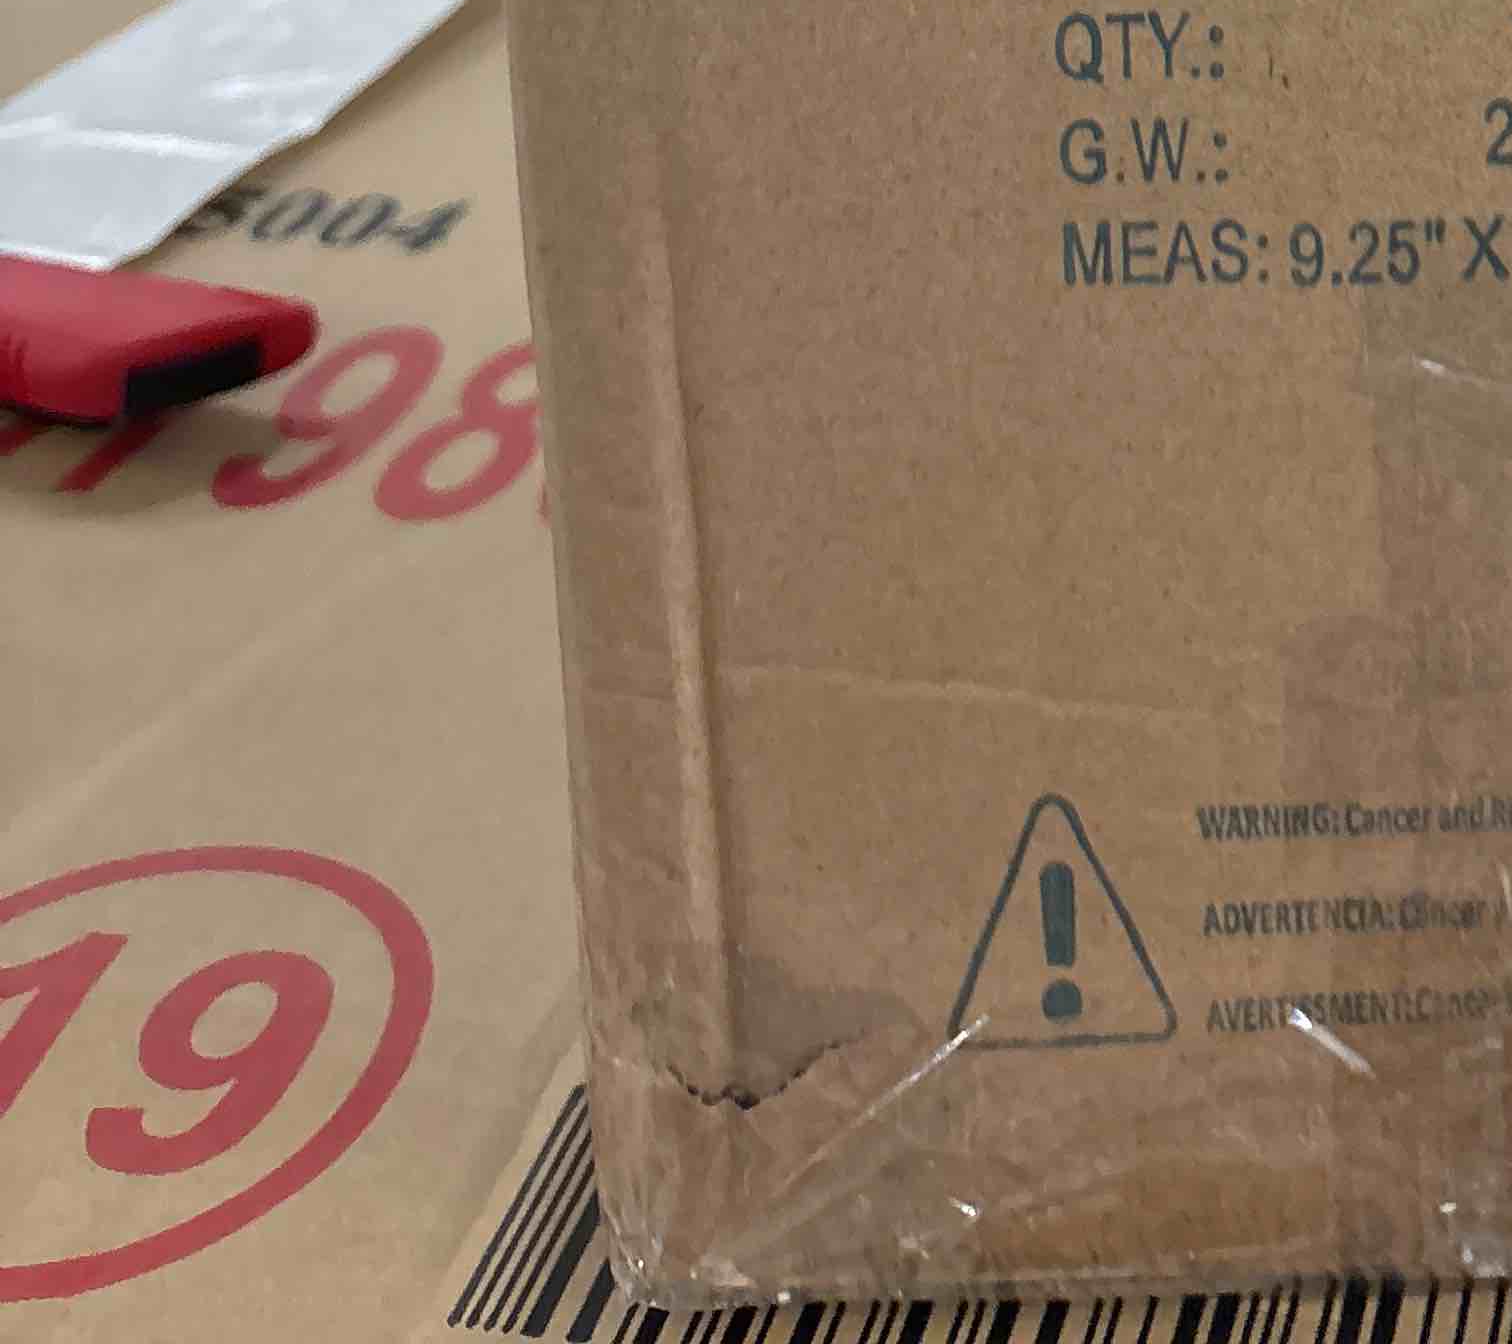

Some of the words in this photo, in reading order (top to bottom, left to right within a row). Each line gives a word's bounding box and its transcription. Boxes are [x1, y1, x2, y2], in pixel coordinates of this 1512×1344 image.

[1054, 11, 1225, 83] QTY.:
[1059, 117, 1229, 184] G.W.:
[1062, 219, 1269, 287] MEAS:
[1197, 801, 1340, 842] WARNING:
[1344, 799, 1432, 839] Cancer
[0, 930, 335, 1176] 19
